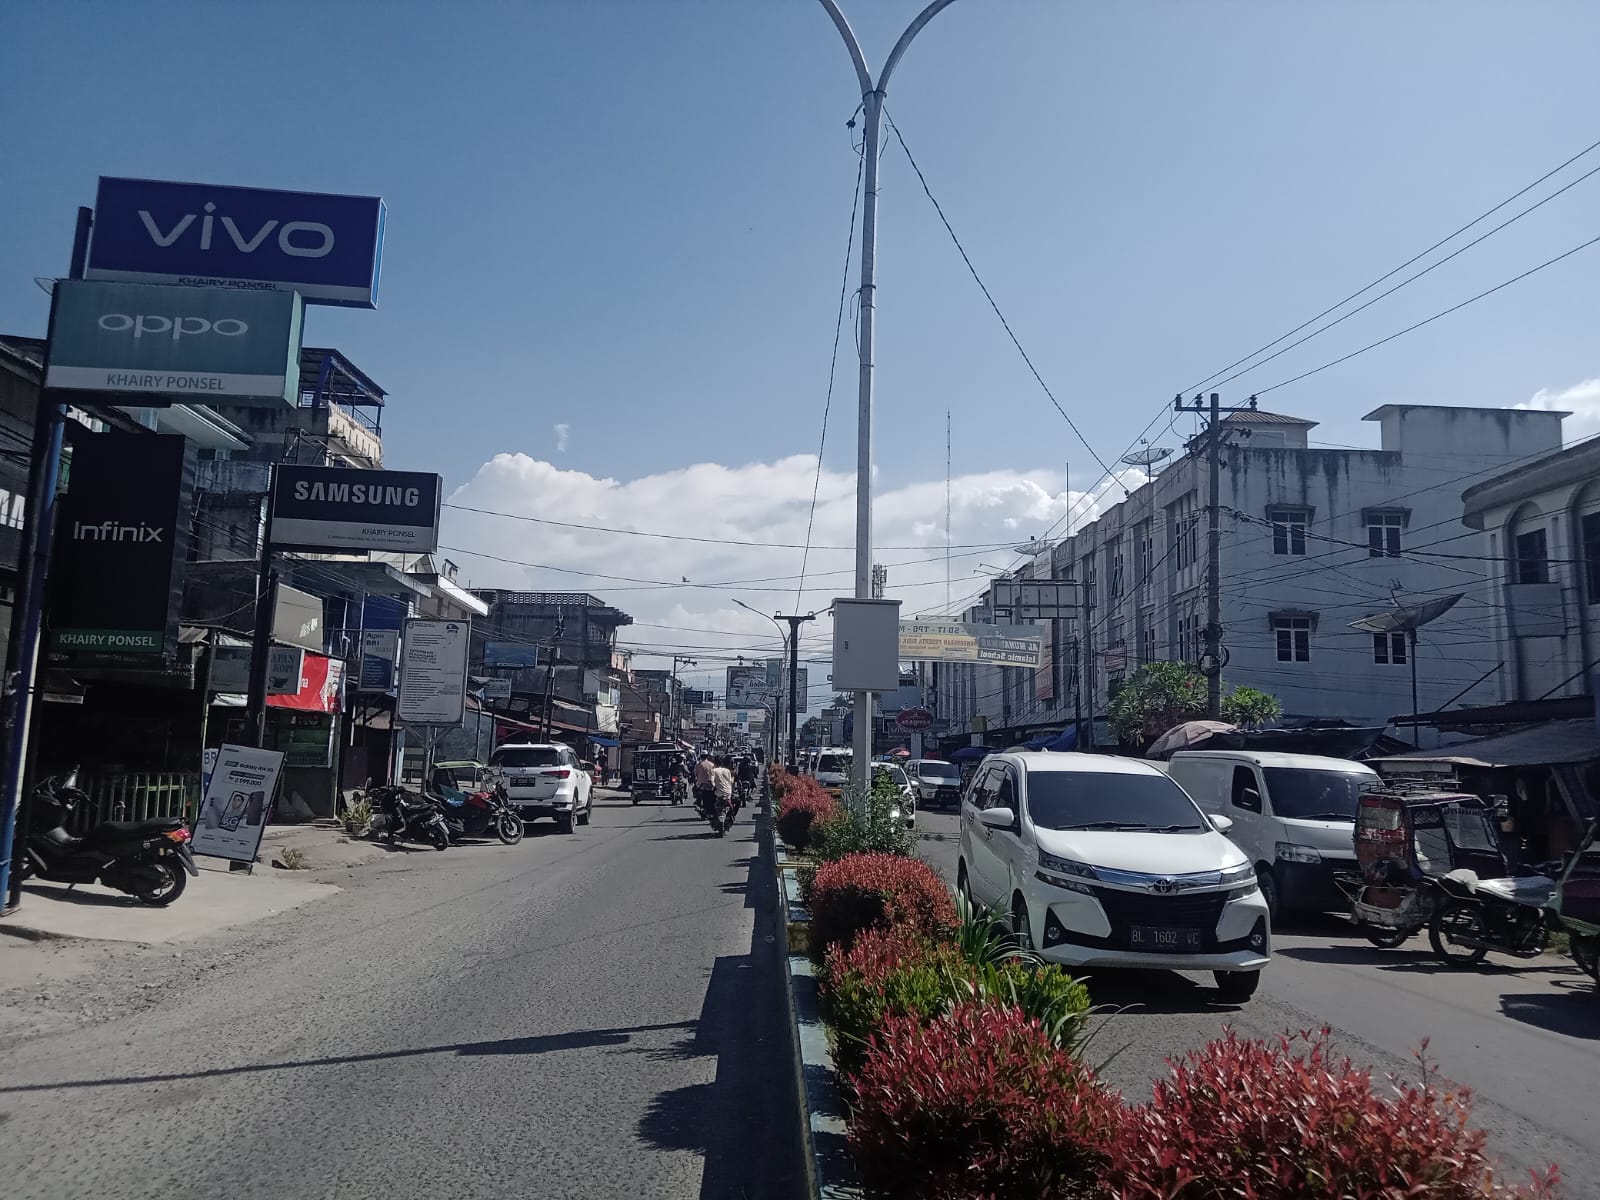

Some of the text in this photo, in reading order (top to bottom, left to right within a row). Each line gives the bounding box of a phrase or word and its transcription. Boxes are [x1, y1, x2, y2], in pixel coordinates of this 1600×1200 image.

[138, 201, 335, 258] vivo
[178, 276, 279, 290] KHAIRY PONSEL
[98, 313, 249, 340] oppo
[106, 373, 225, 391] KHAIRY PONSEL
[294, 480, 419, 507] SAMSUNG
[73, 520, 165, 543] Infinix
[361, 527, 416, 538] KHAIRY PONSEL
[59, 633, 156, 647] KHAIRY PONSEL
[1132, 929, 1145, 943] BL
[1153, 930, 1178, 944] 1602
